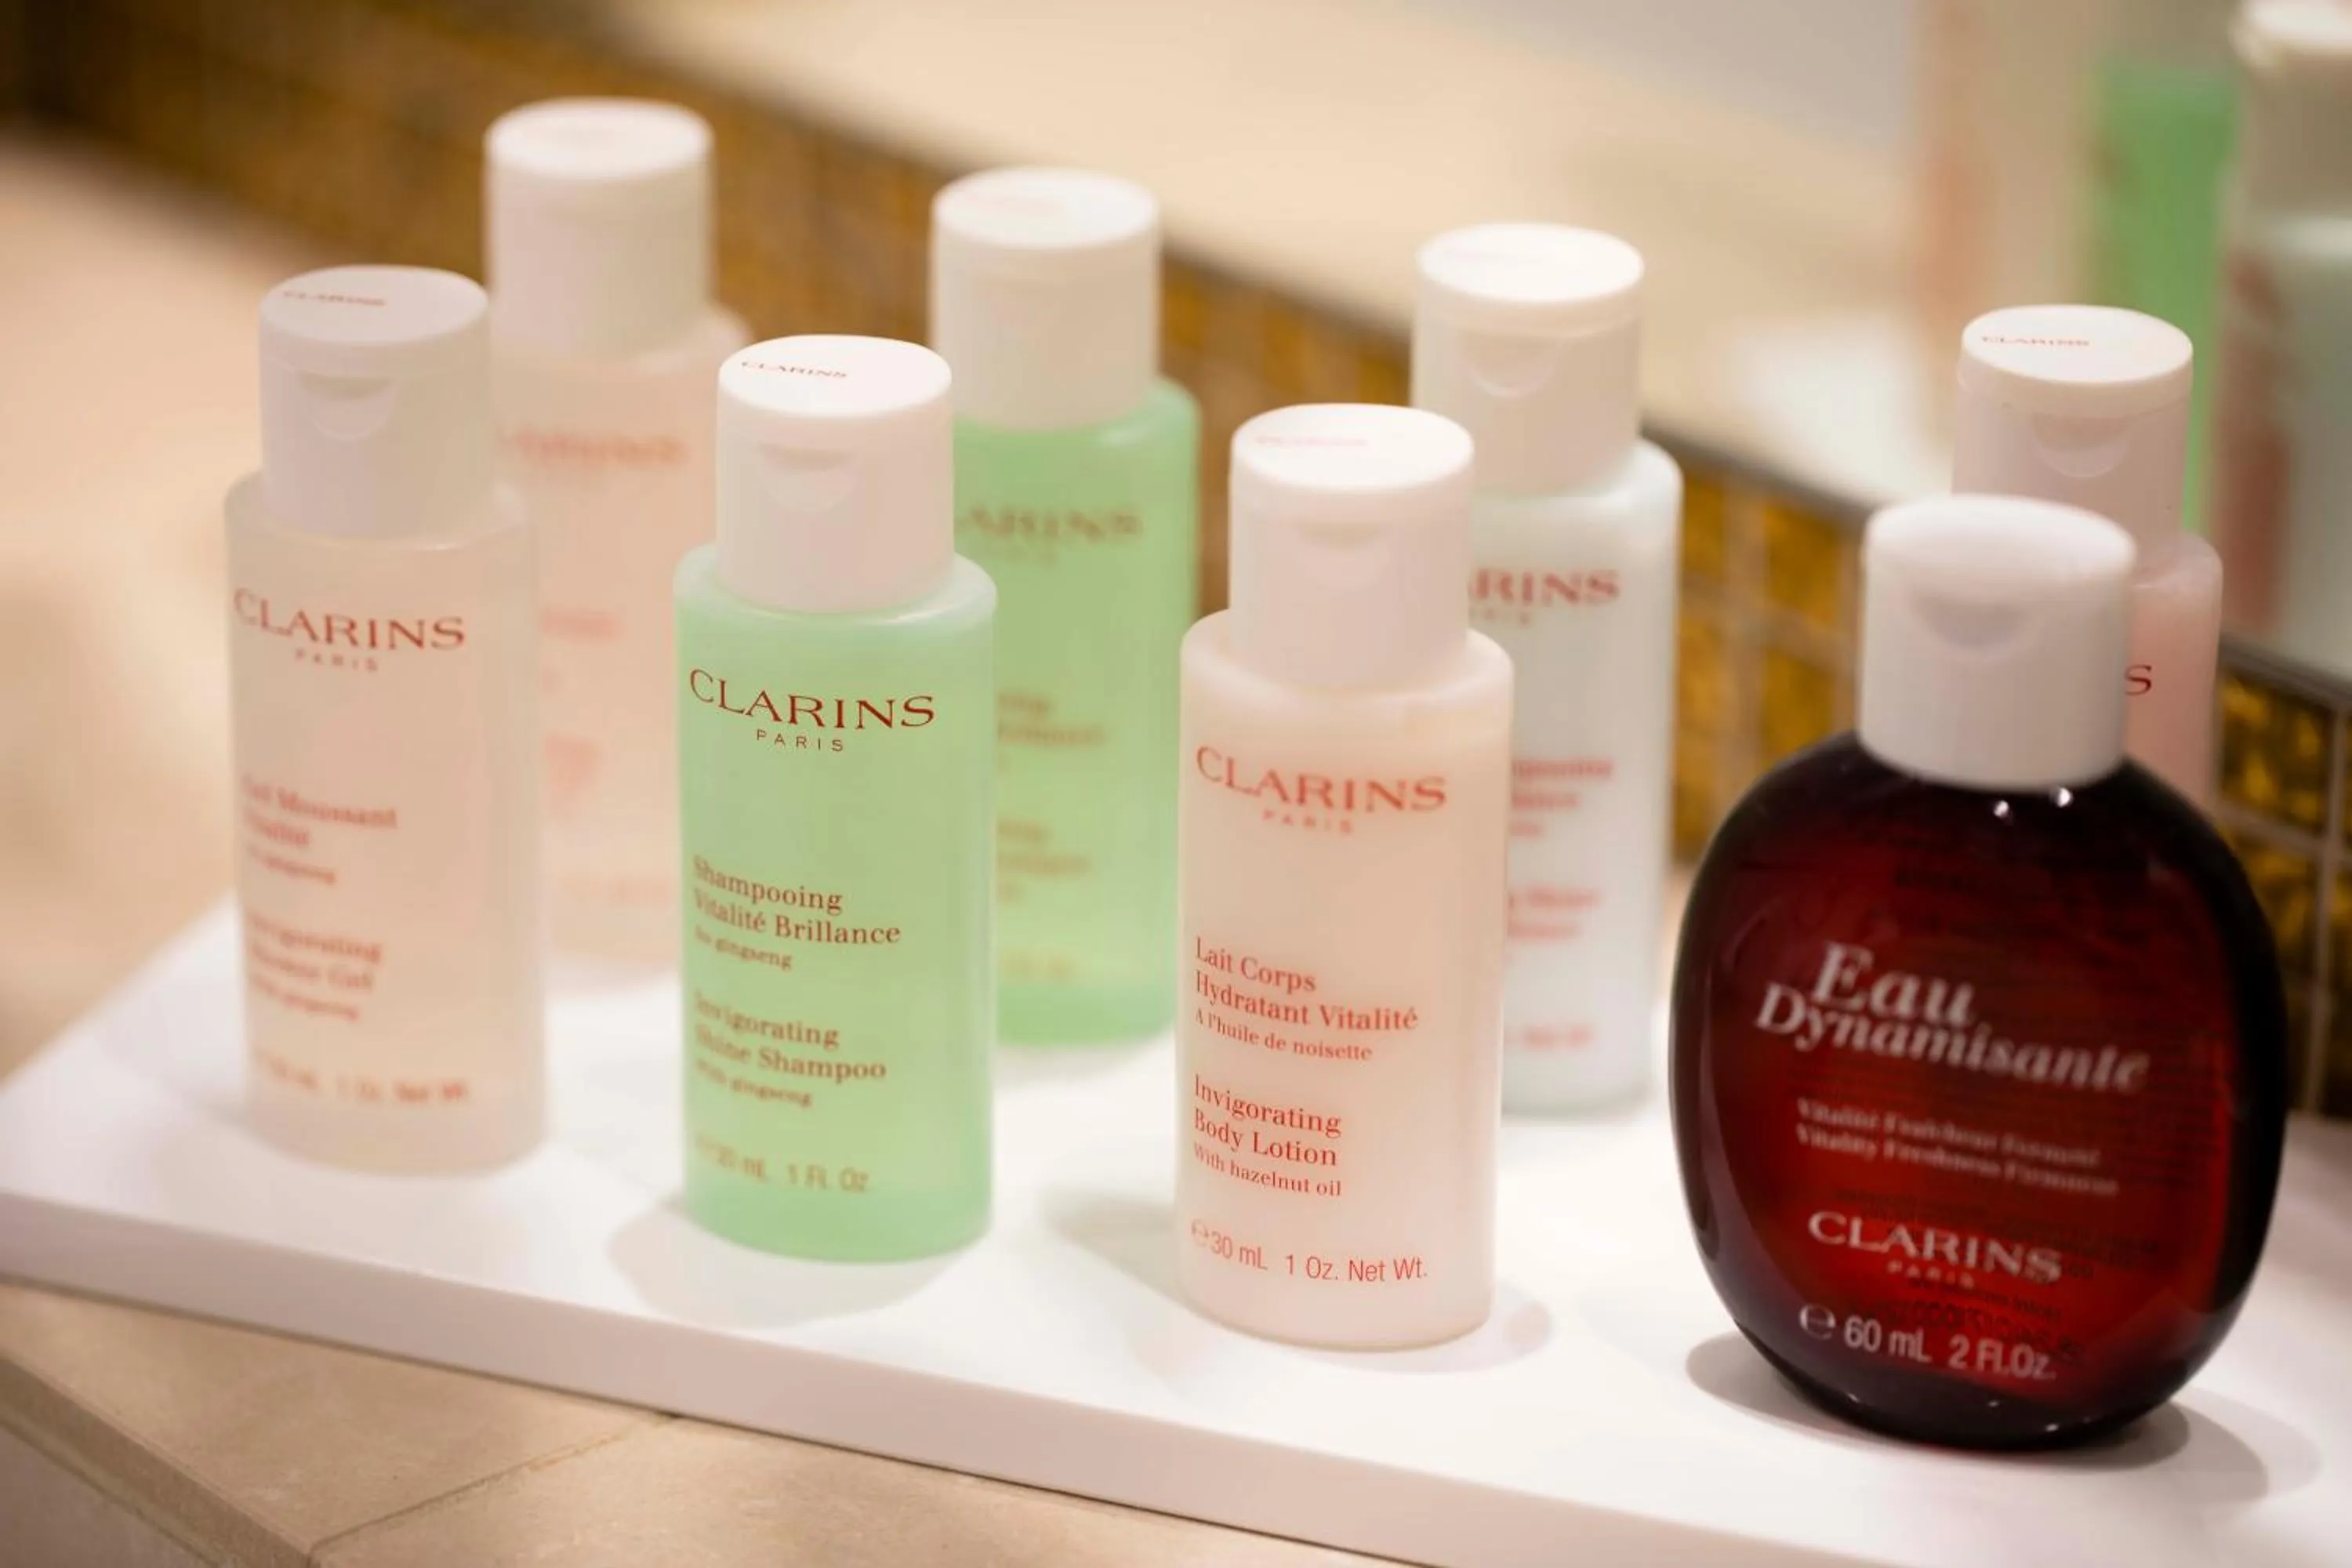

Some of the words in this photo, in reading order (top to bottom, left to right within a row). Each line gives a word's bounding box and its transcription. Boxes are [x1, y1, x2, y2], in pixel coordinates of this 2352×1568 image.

[741, 361, 848, 378] CLARINS
[1469, 568, 1620, 608] RINS
[234, 588, 466, 650] CLARINS
[690, 669, 936, 730] CLARINS
[757, 729, 844, 753] PARIS
[1196, 746, 1448, 813] CLARINS
[1262, 808, 1354, 835] PARIS
[694, 855, 843, 916] Shampooing
[775, 914, 902, 945] Brillance
[1196, 937, 1233, 975] Lait
[1240, 956, 1317, 995] Corps
[1812, 941, 1976, 1028] Eau
[1196, 971, 1311, 1027] Hydratant
[1317, 1005, 1419, 1032] Vitalité
[757, 1046, 887, 1085] Shampoo
[1208, 1012, 1260, 1046] l'huile
[1264, 1033, 1287, 1052] de
[1292, 1040, 1373, 1062] noisette
[1755, 982, 2151, 1094] Dynamisante
[1194, 1074, 1342, 1137] Invigorating
[1194, 1108, 1243, 1152] Body
[1253, 1131, 1338, 1167] Lotion
[1194, 1142, 1225, 1173] With
[1229, 1158, 1310, 1192] hazelnut
[1316, 1180, 1343, 1196] oil
[1239, 1247, 1268, 1270] mL
[1286, 1254, 1294, 1275] 1
[1305, 1256, 1338, 1281] Oz.
[1348, 1258, 1385, 1283] Net
[1393, 1256, 1428, 1281] Wt.
[1807, 1210, 2063, 1283] CLARINS
[1843, 1315, 1882, 1352] 60
[1889, 1327, 1932, 1363] mL
[1948, 1335, 1970, 1370] 2
